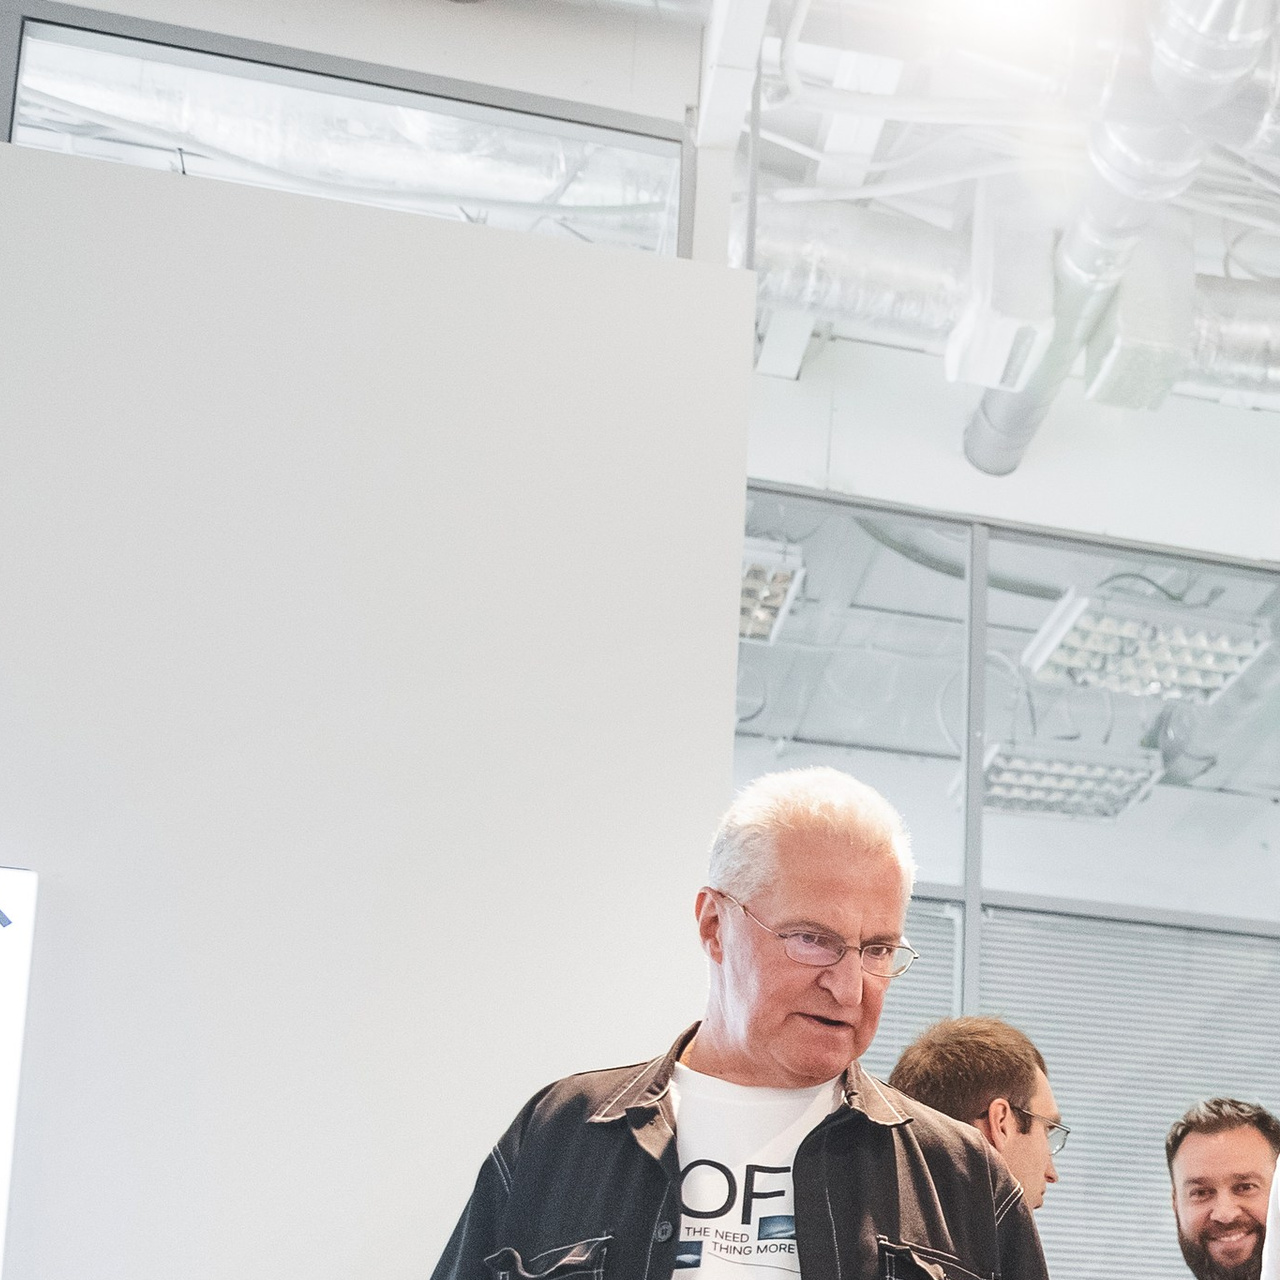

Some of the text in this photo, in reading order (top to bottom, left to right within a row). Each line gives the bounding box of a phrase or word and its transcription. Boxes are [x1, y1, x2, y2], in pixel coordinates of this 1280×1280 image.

[681, 1159, 791, 1225] OF
[685, 1226, 750, 1243] THE NEED
[712, 1241, 796, 1256] THING MORE
